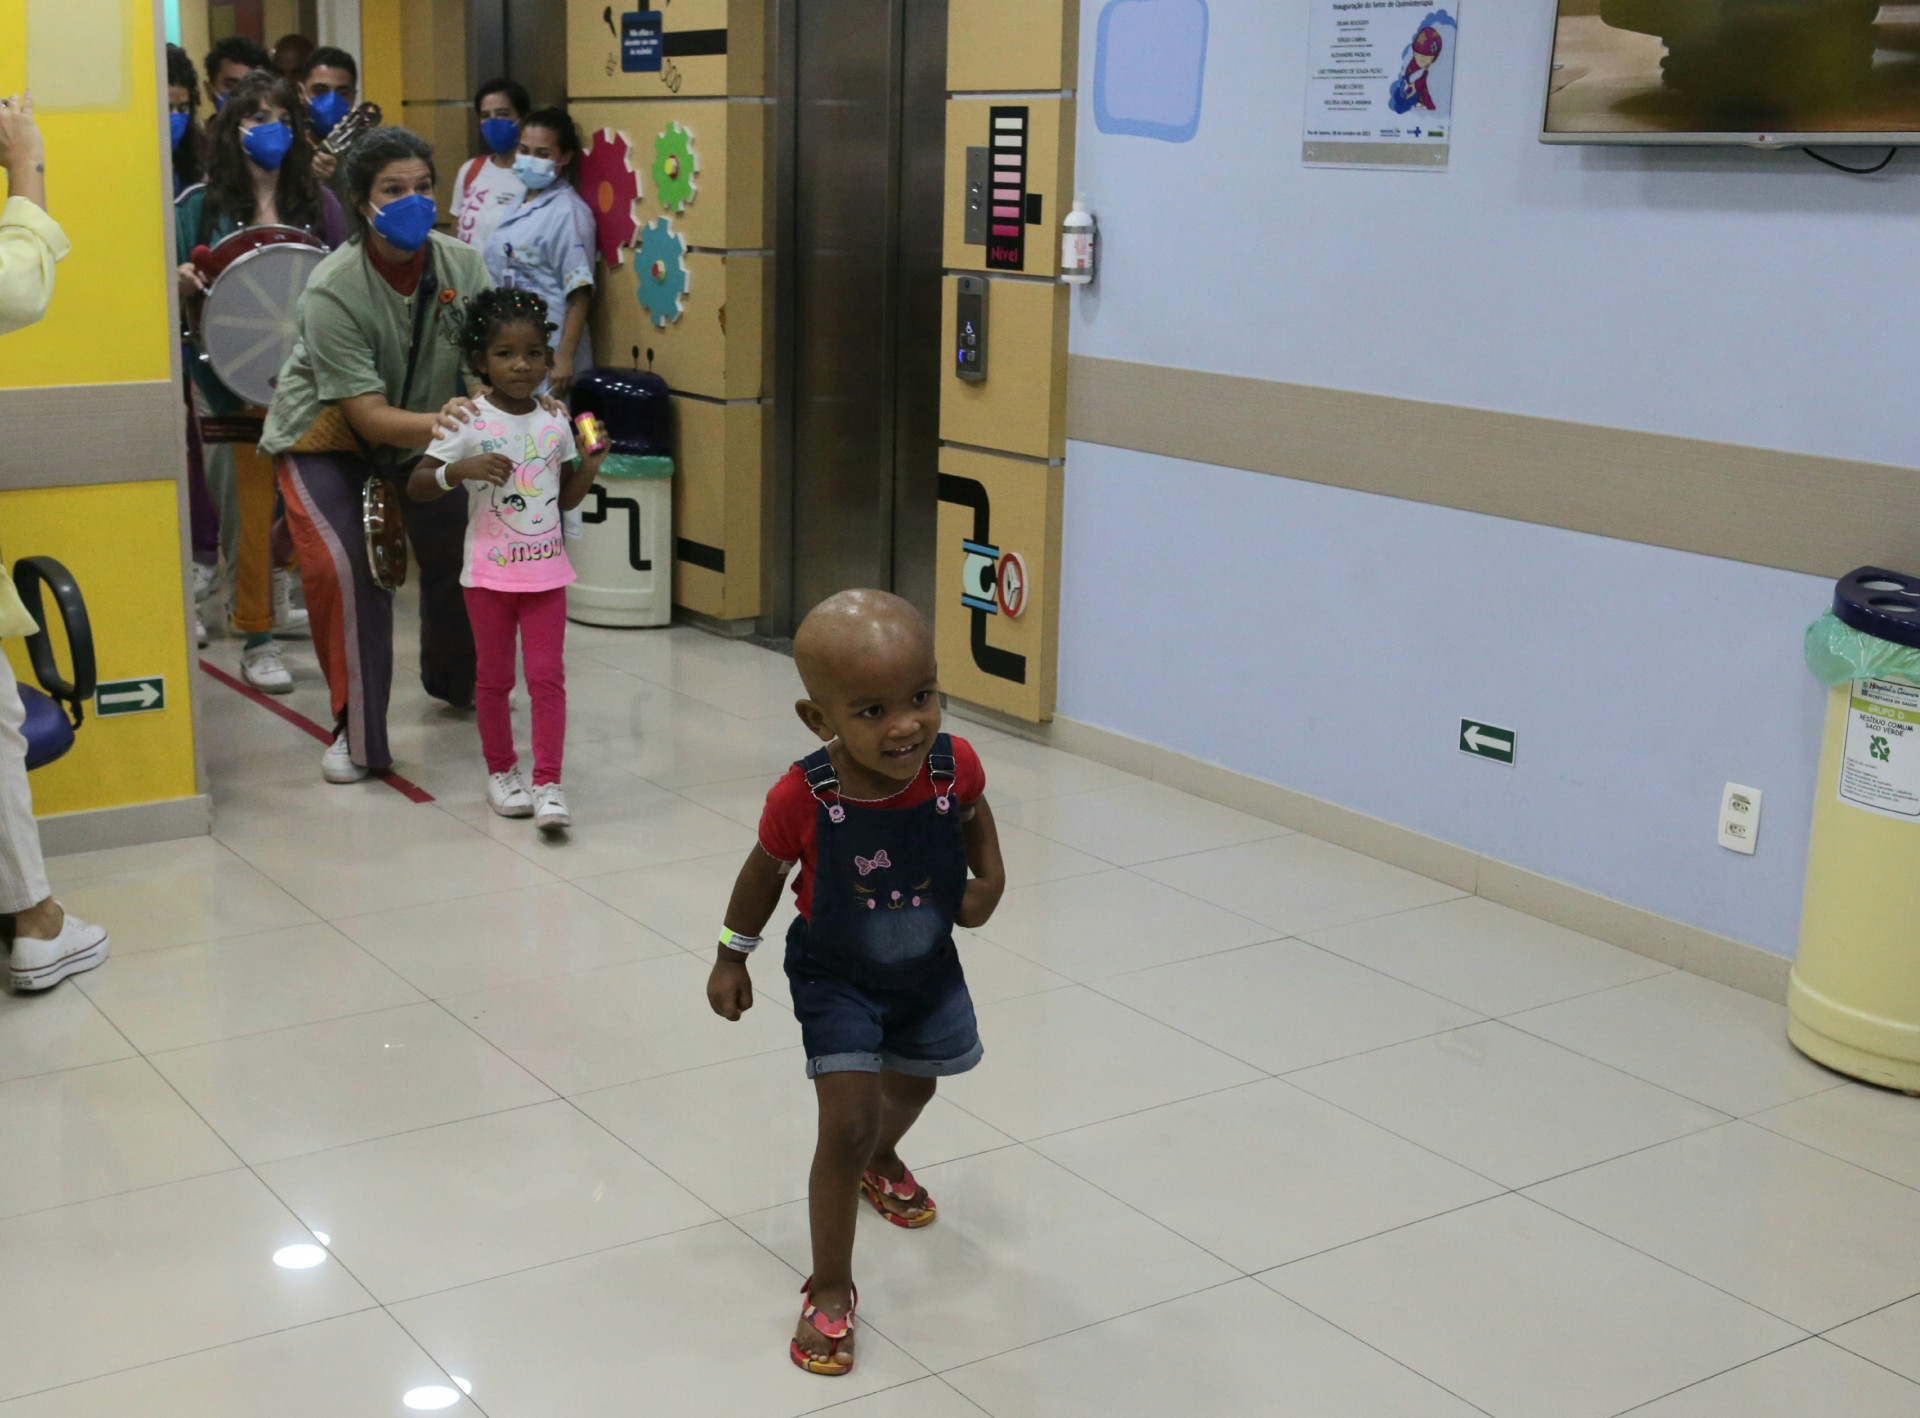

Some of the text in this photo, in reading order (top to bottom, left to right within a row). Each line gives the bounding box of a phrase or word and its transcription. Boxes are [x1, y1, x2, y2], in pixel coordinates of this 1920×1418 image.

[1333, 3, 1364, 11] Inauguração
[1395, 0, 1433, 8] Quimioterapia
[1869, 704, 1905, 720] GRUPO D
[1860, 713, 1914, 732] RESÍDUO COMUM
[1865, 722, 1904, 737] SACO VERDE
